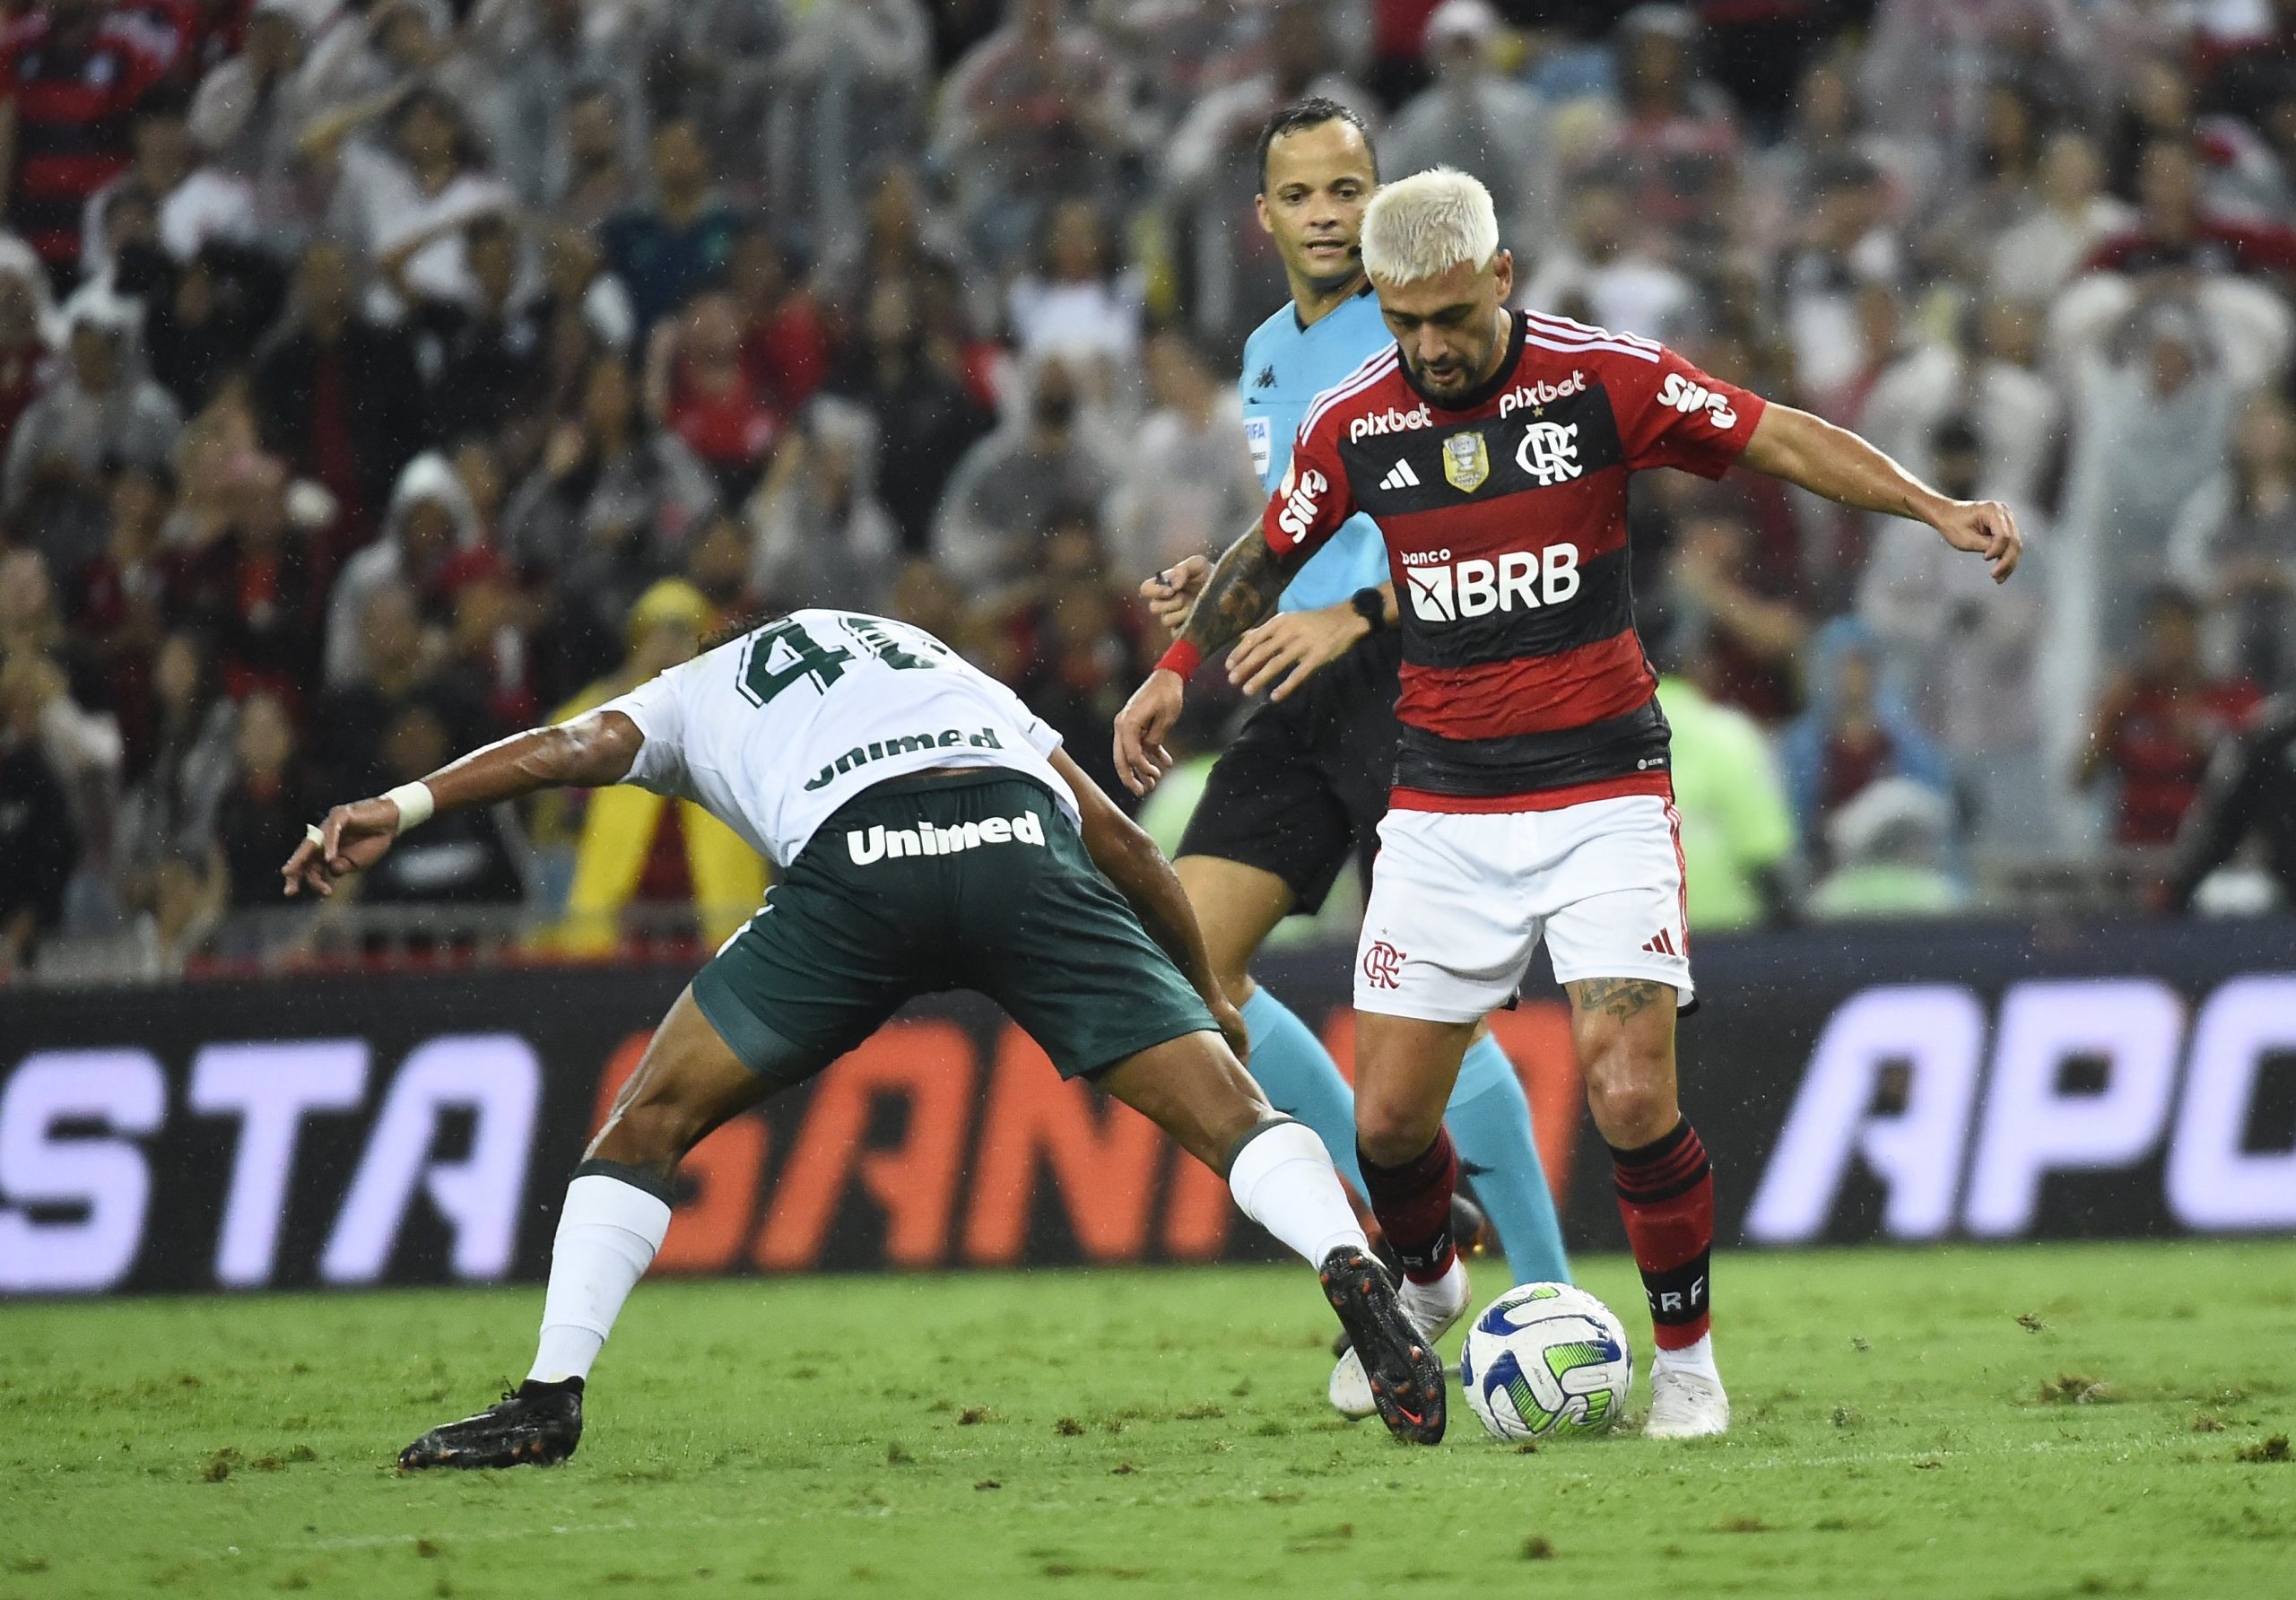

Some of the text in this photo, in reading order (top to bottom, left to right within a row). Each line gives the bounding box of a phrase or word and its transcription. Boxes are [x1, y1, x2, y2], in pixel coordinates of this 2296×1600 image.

[1499, 369, 1586, 420] pixbet
[1350, 402, 1433, 445] pixbet
[1400, 547, 1451, 565] banco
[1456, 542, 1581, 619] BRB
[847, 809, 1046, 866] Unimed
[0, 1031, 543, 1296] STA
